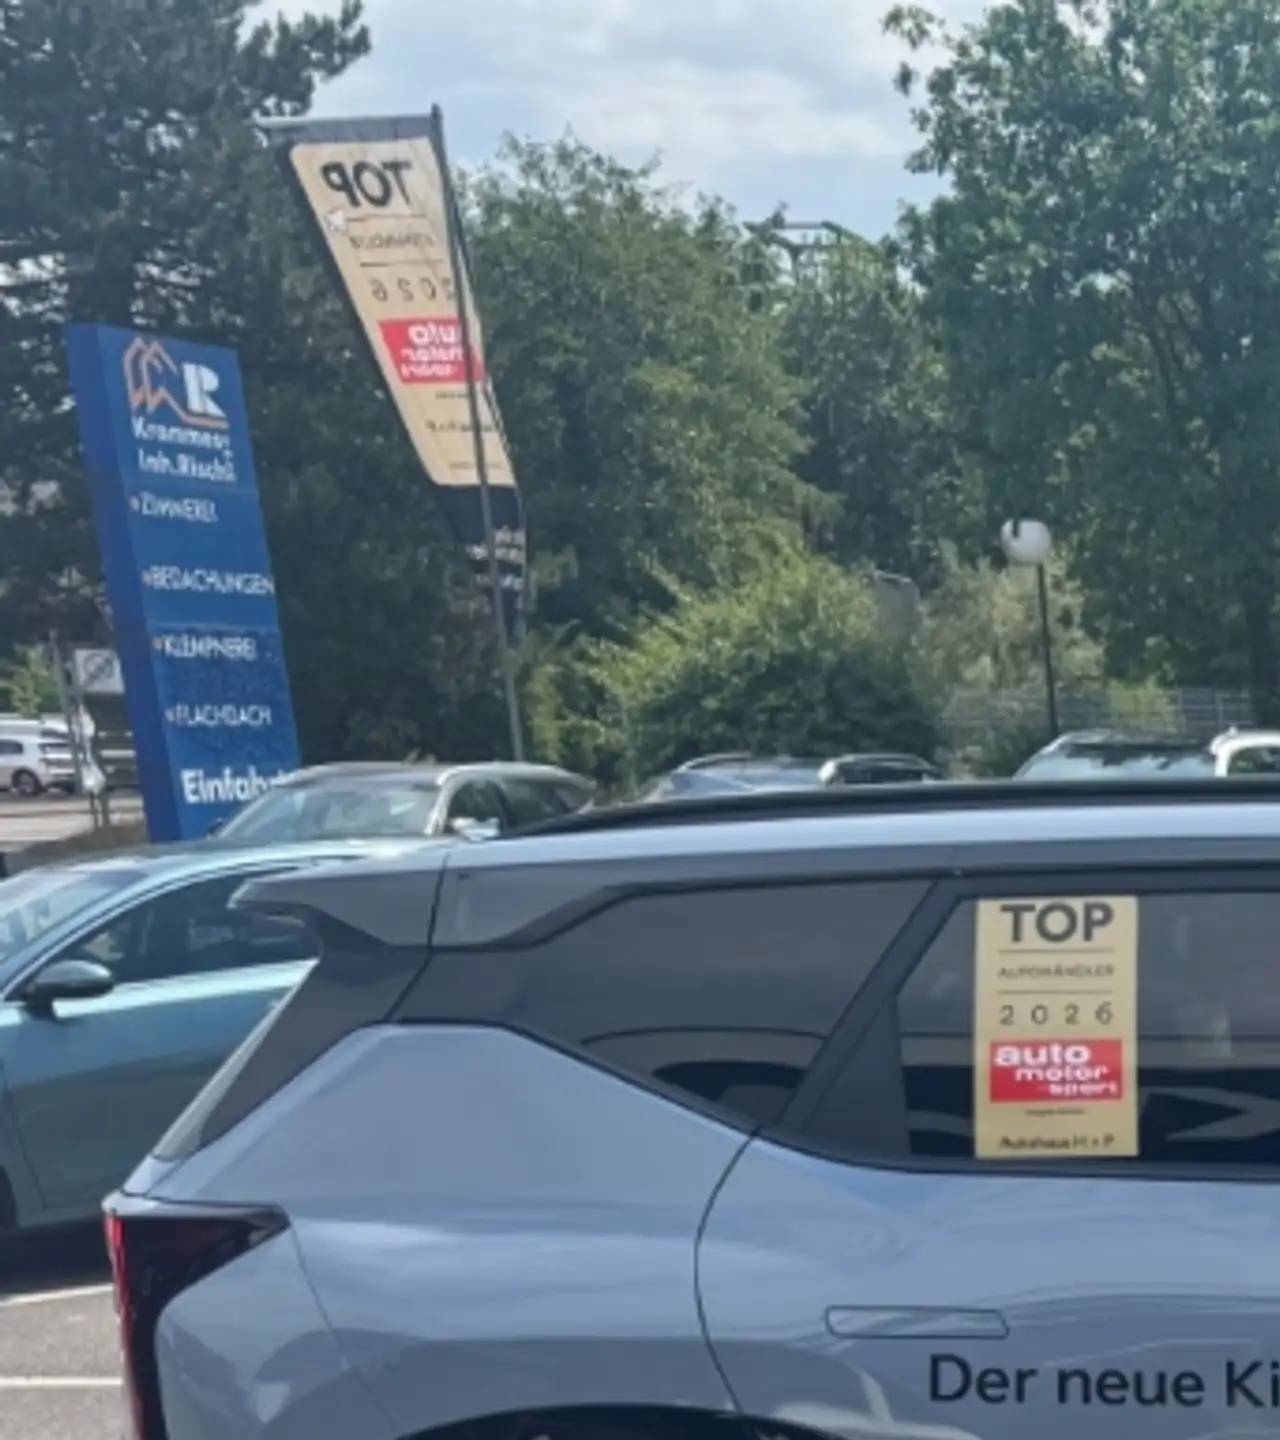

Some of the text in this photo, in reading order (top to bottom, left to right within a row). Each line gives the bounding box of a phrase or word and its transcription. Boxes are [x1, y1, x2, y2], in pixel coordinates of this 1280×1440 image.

[150, 565, 275, 595] BEDACHUNGEN
[1000, 902, 1115, 943] TOP
[1000, 1002, 1114, 1026] 2026
[994, 1042, 1090, 1067] auto
[1014, 1064, 1111, 1082] motor
[928, 1353, 1038, 1404] Der
[1056, 1367, 1205, 1407] neue
